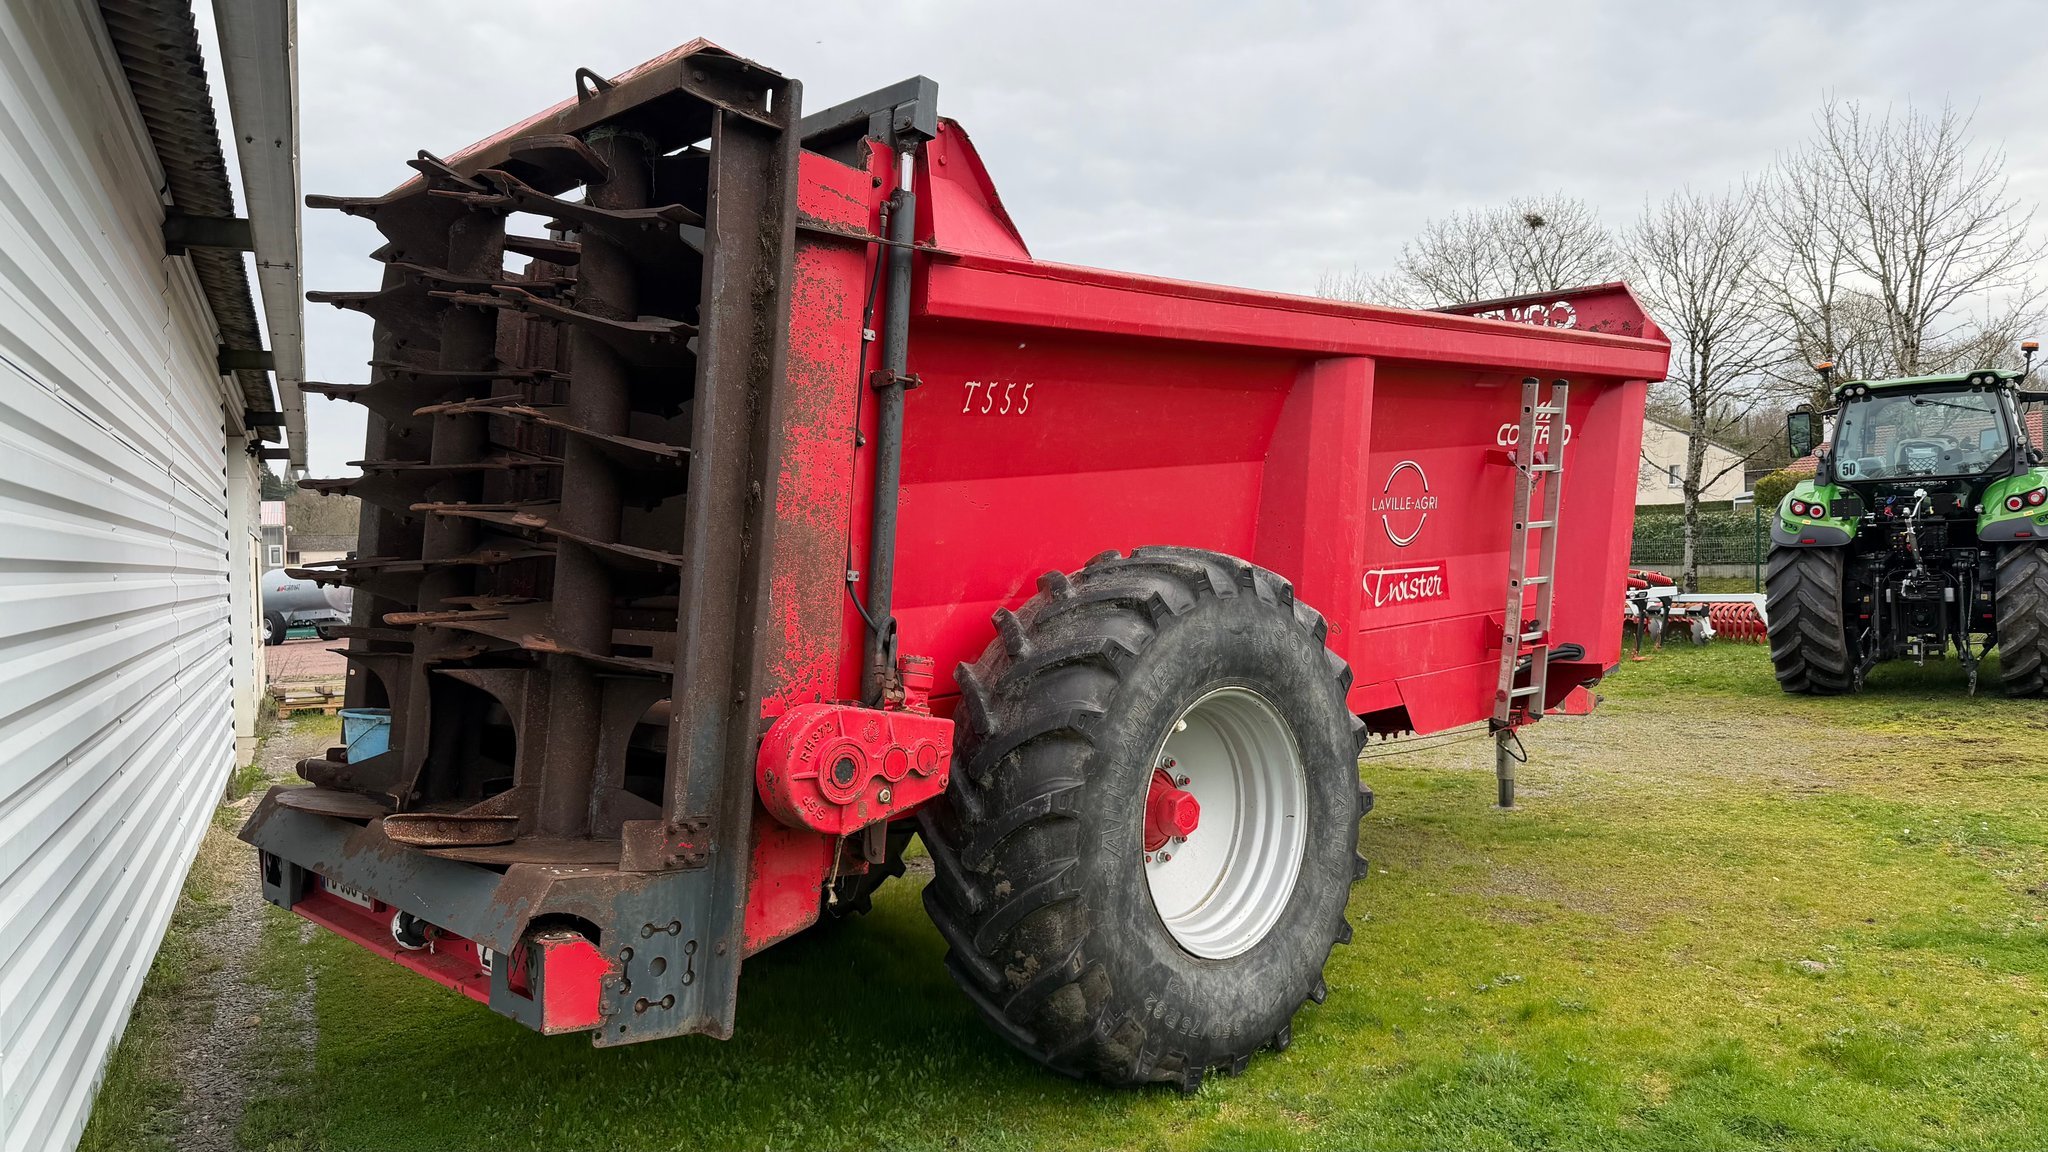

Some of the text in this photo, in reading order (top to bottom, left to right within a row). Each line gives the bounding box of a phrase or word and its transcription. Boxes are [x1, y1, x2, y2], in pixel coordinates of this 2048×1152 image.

[962, 381, 1034, 415] T555
[1497, 424, 1572, 446] COTAD
[1842, 462, 1856, 476] 50
[1372, 496, 1438, 511] LAVILLE-AGRI
[1362, 565, 1443, 607] Twister
